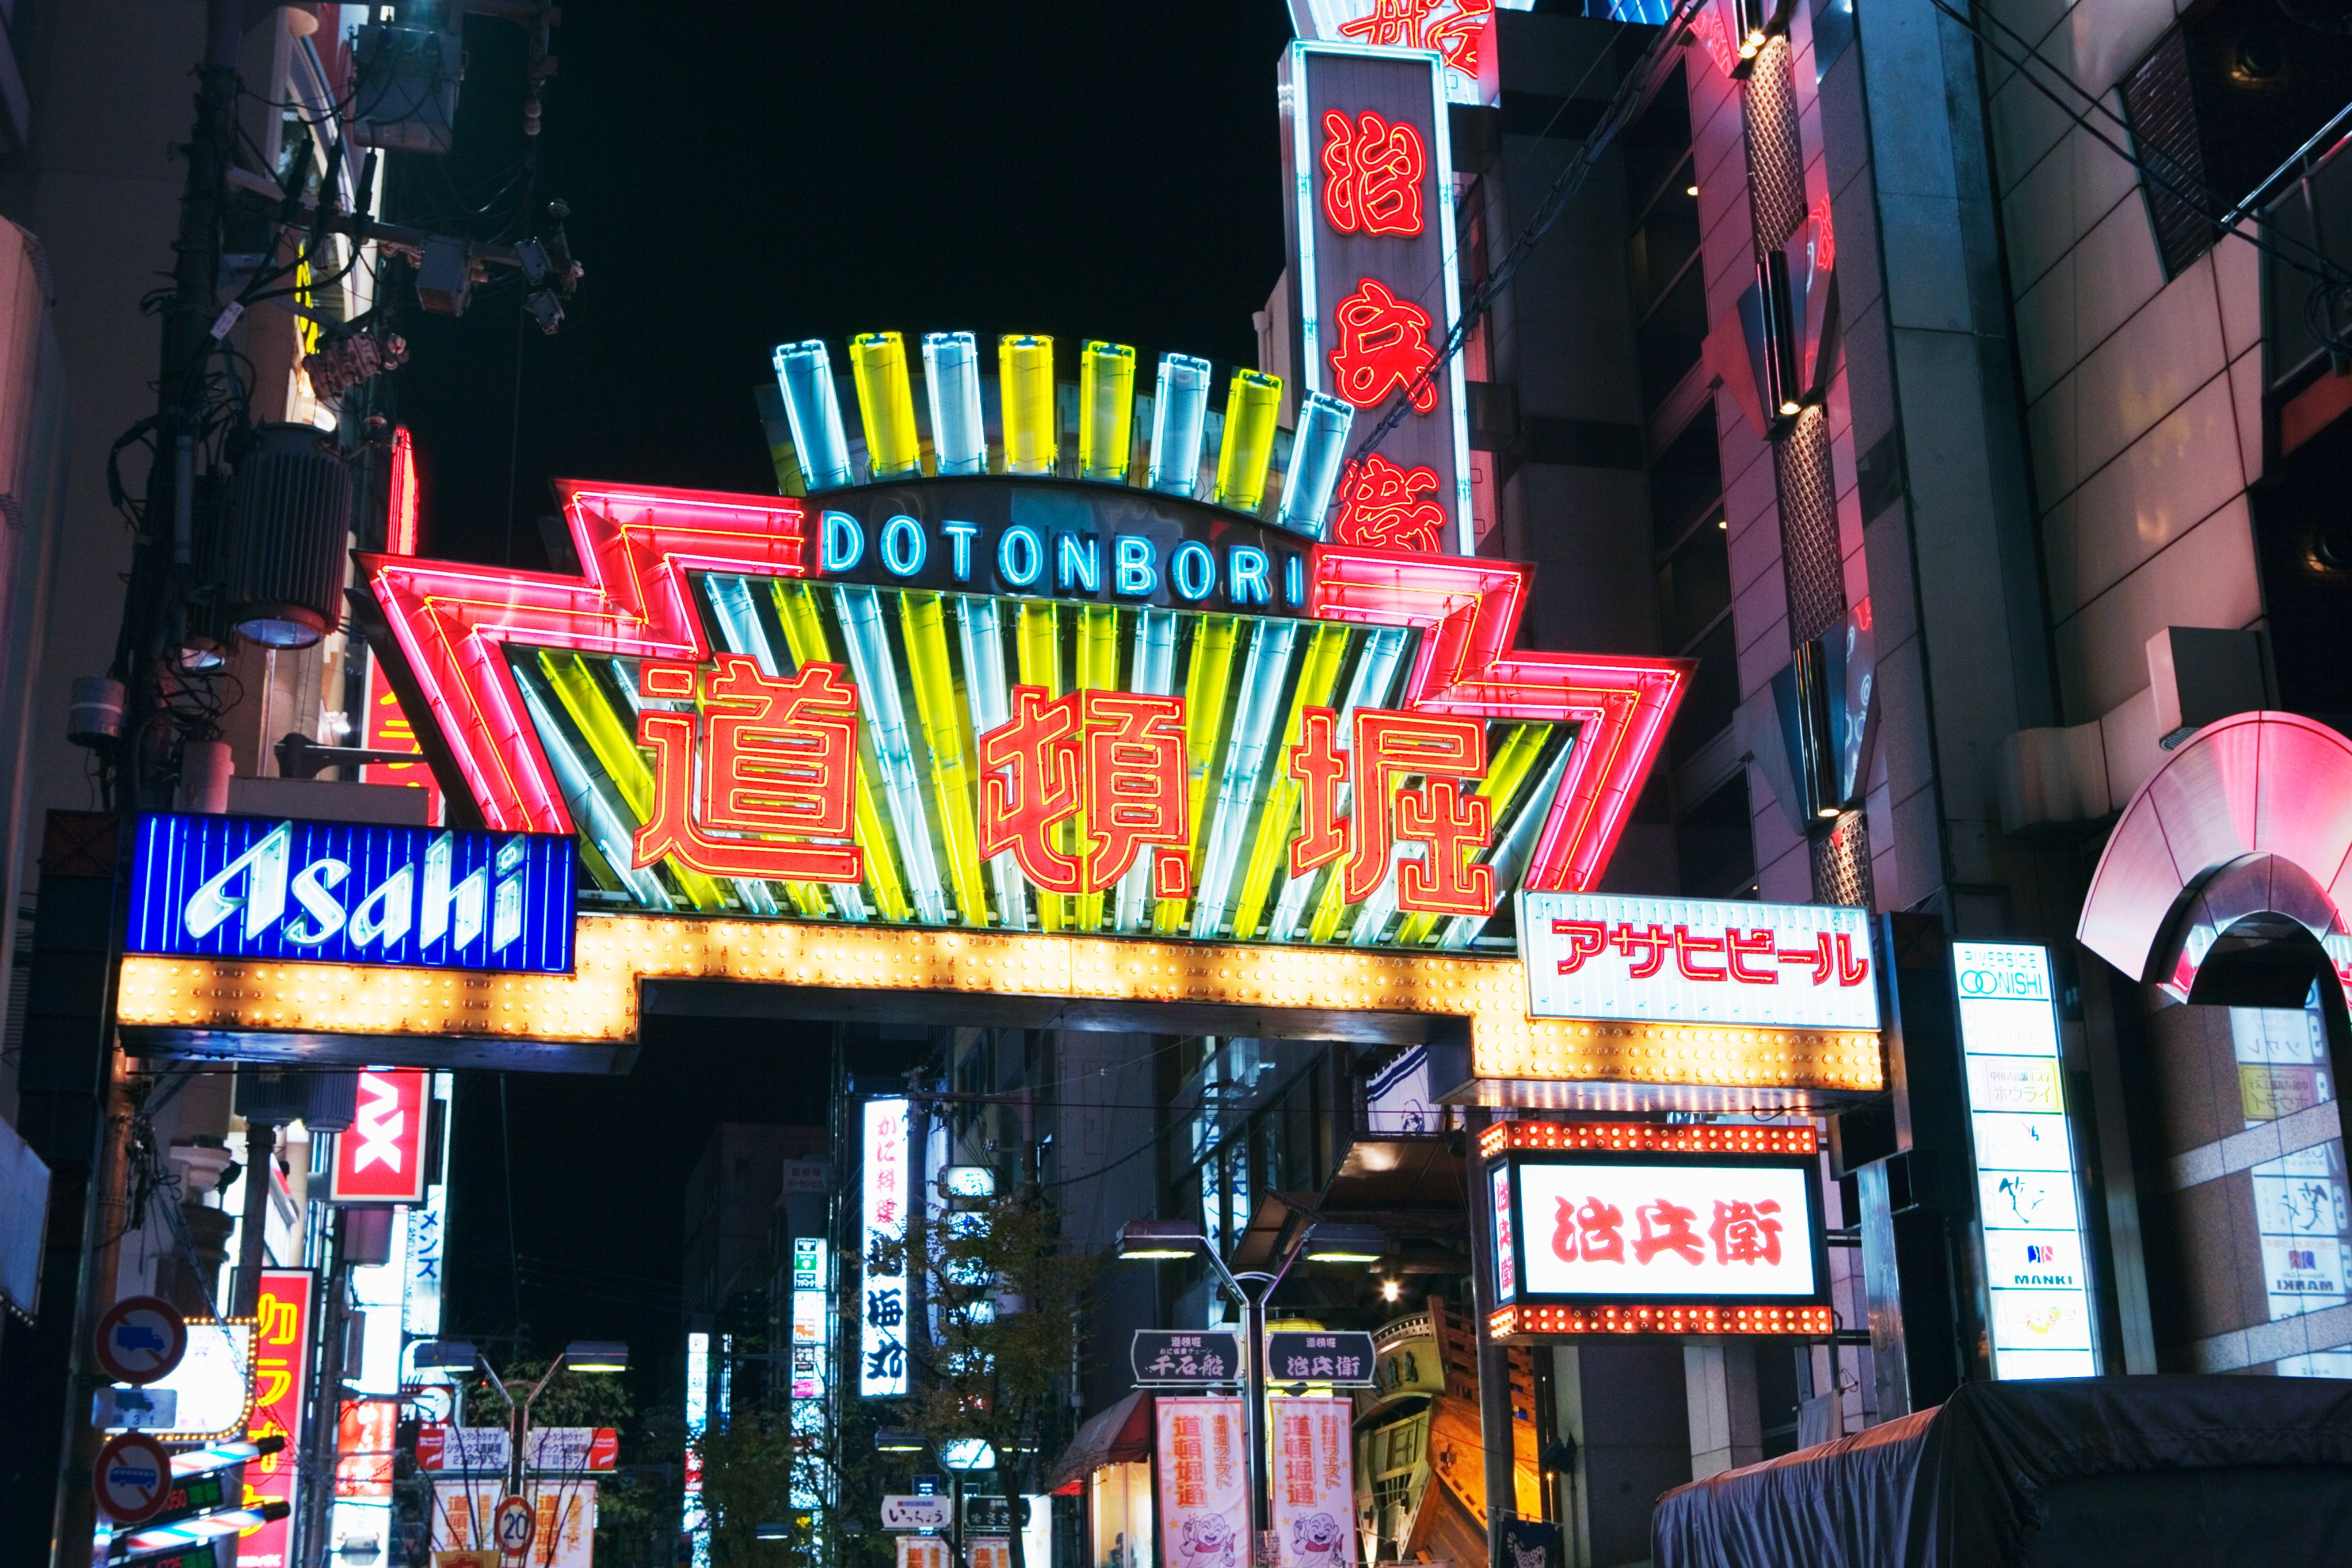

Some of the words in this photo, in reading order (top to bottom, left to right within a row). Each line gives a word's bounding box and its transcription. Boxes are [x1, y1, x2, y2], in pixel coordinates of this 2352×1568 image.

[821, 510, 1304, 610] DOTONBORI
[633, 651, 1497, 917] 道頓堀
[184, 819, 526, 955] Asahi
[1551, 919, 1869, 988] アサヒビール
[1964, 950, 2037, 968] RIVERSIDE
[1994, 1085, 2051, 1104] ホウライ
[876, 1116, 897, 1223] かに料理
[416, 1210, 440, 1279] メンズ
[1551, 1195, 1783, 1267] 治兵衛
[2014, 1275, 2074, 1285] MANKI
[1145, 1354, 1225, 1376] 千石船
[1171, 1337, 1202, 1347] 道頓堀
[1287, 1356, 1361, 1376] 治兵衛
[1306, 1337, 1336, 1348] 道頓堀
[1173, 1415, 1207, 1507] 道頓堀通
[1212, 1414, 1233, 1488] 道頓堀ウエスト
[1284, 1414, 1317, 1507] 道頓堀通
[1320, 1414, 1342, 1488] 道頓堀ウエスト
[504, 1514, 528, 1540] 20
[889, 1508, 943, 1523] いっちょう
